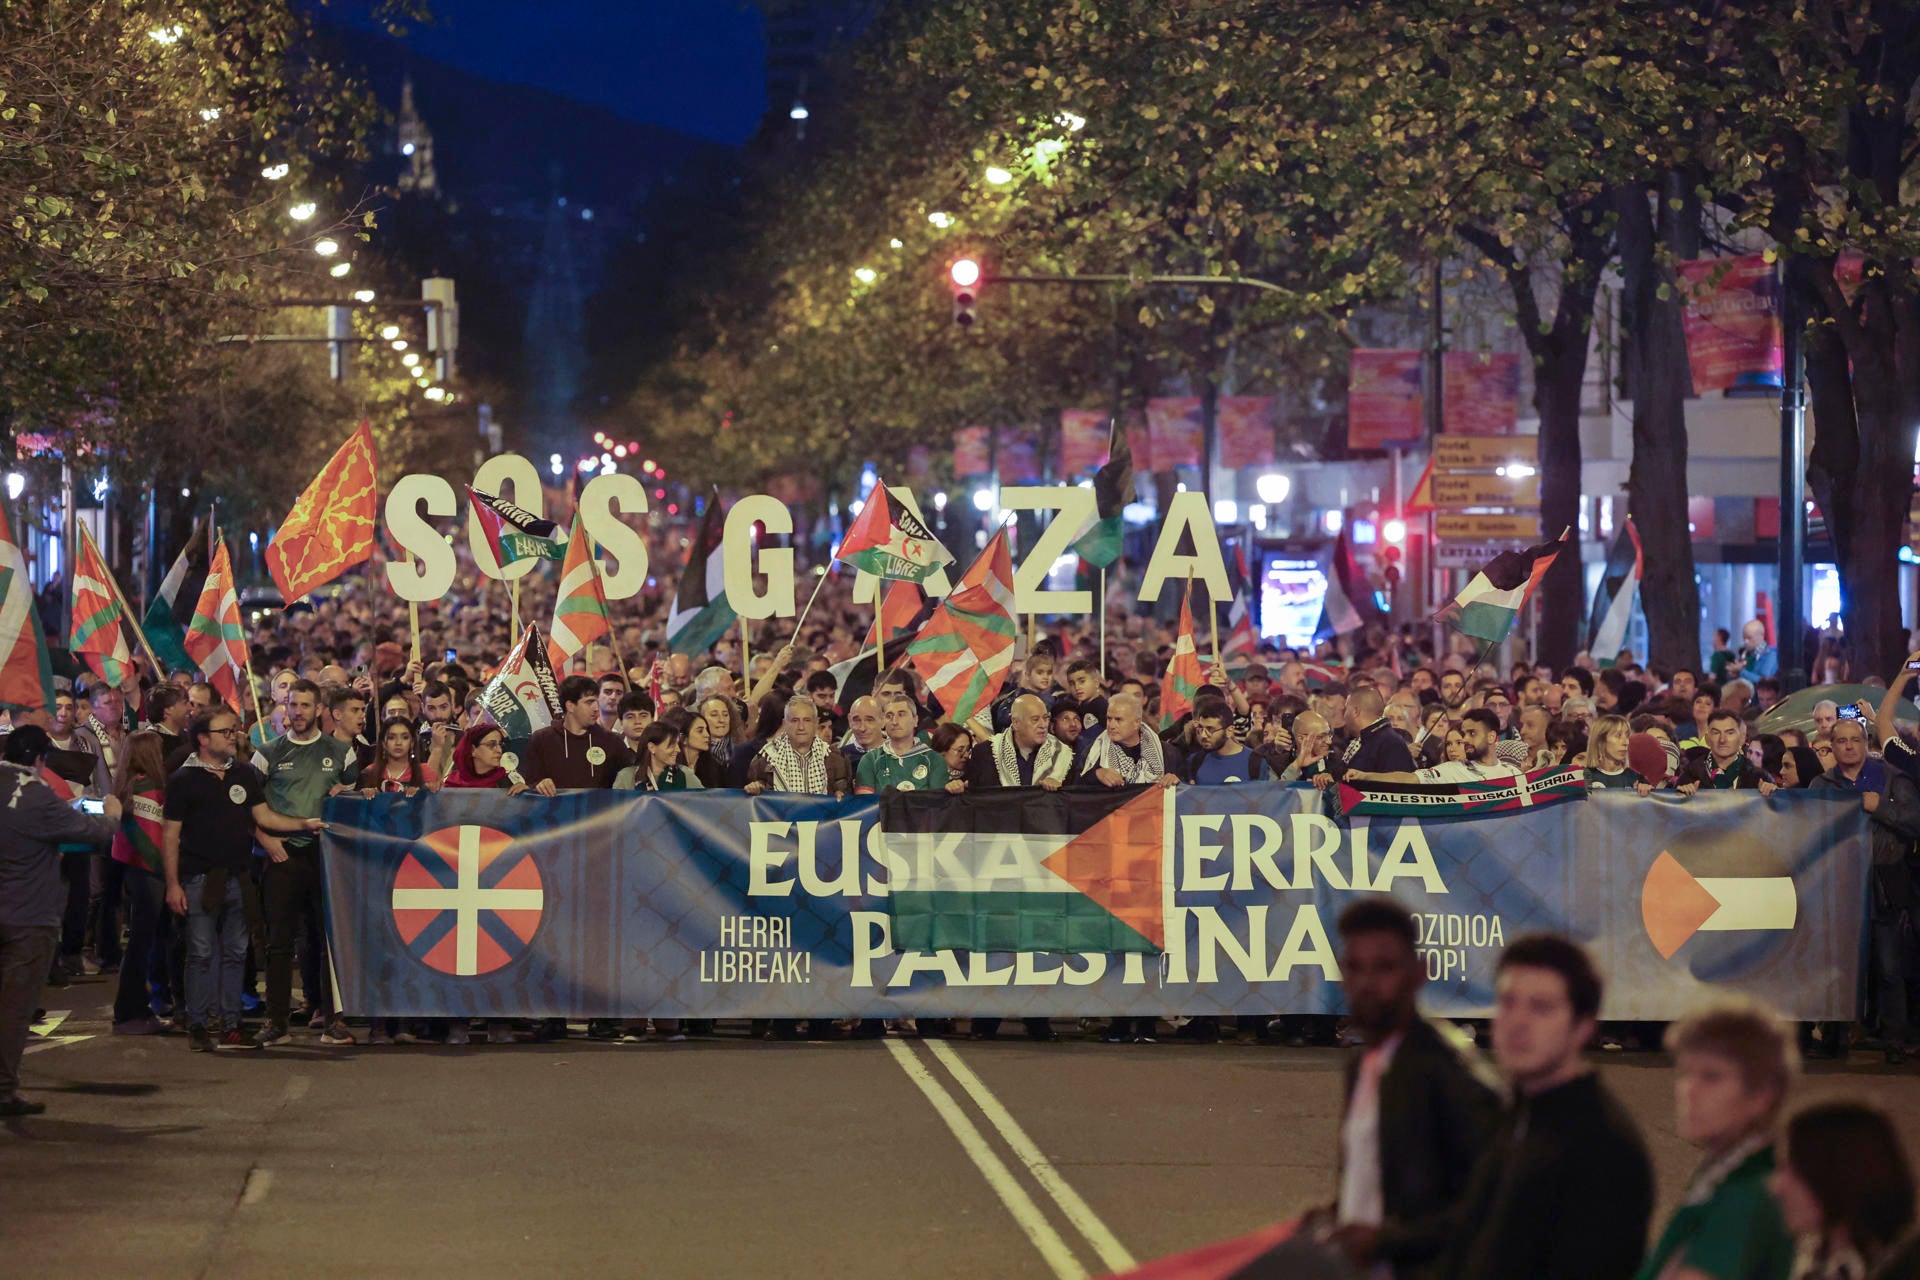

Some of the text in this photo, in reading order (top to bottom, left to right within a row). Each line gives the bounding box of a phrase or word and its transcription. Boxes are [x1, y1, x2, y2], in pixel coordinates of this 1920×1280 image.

[384, 453, 649, 602] SOS
[885, 554, 921, 578] LIBRE
[1369, 773, 1576, 804] PALESTINA EUSKAL HERRIA
[1109, 813, 1450, 894] HERRIA
[720, 915, 791, 948] HERRI
[699, 950, 811, 983] LIBREAK!
